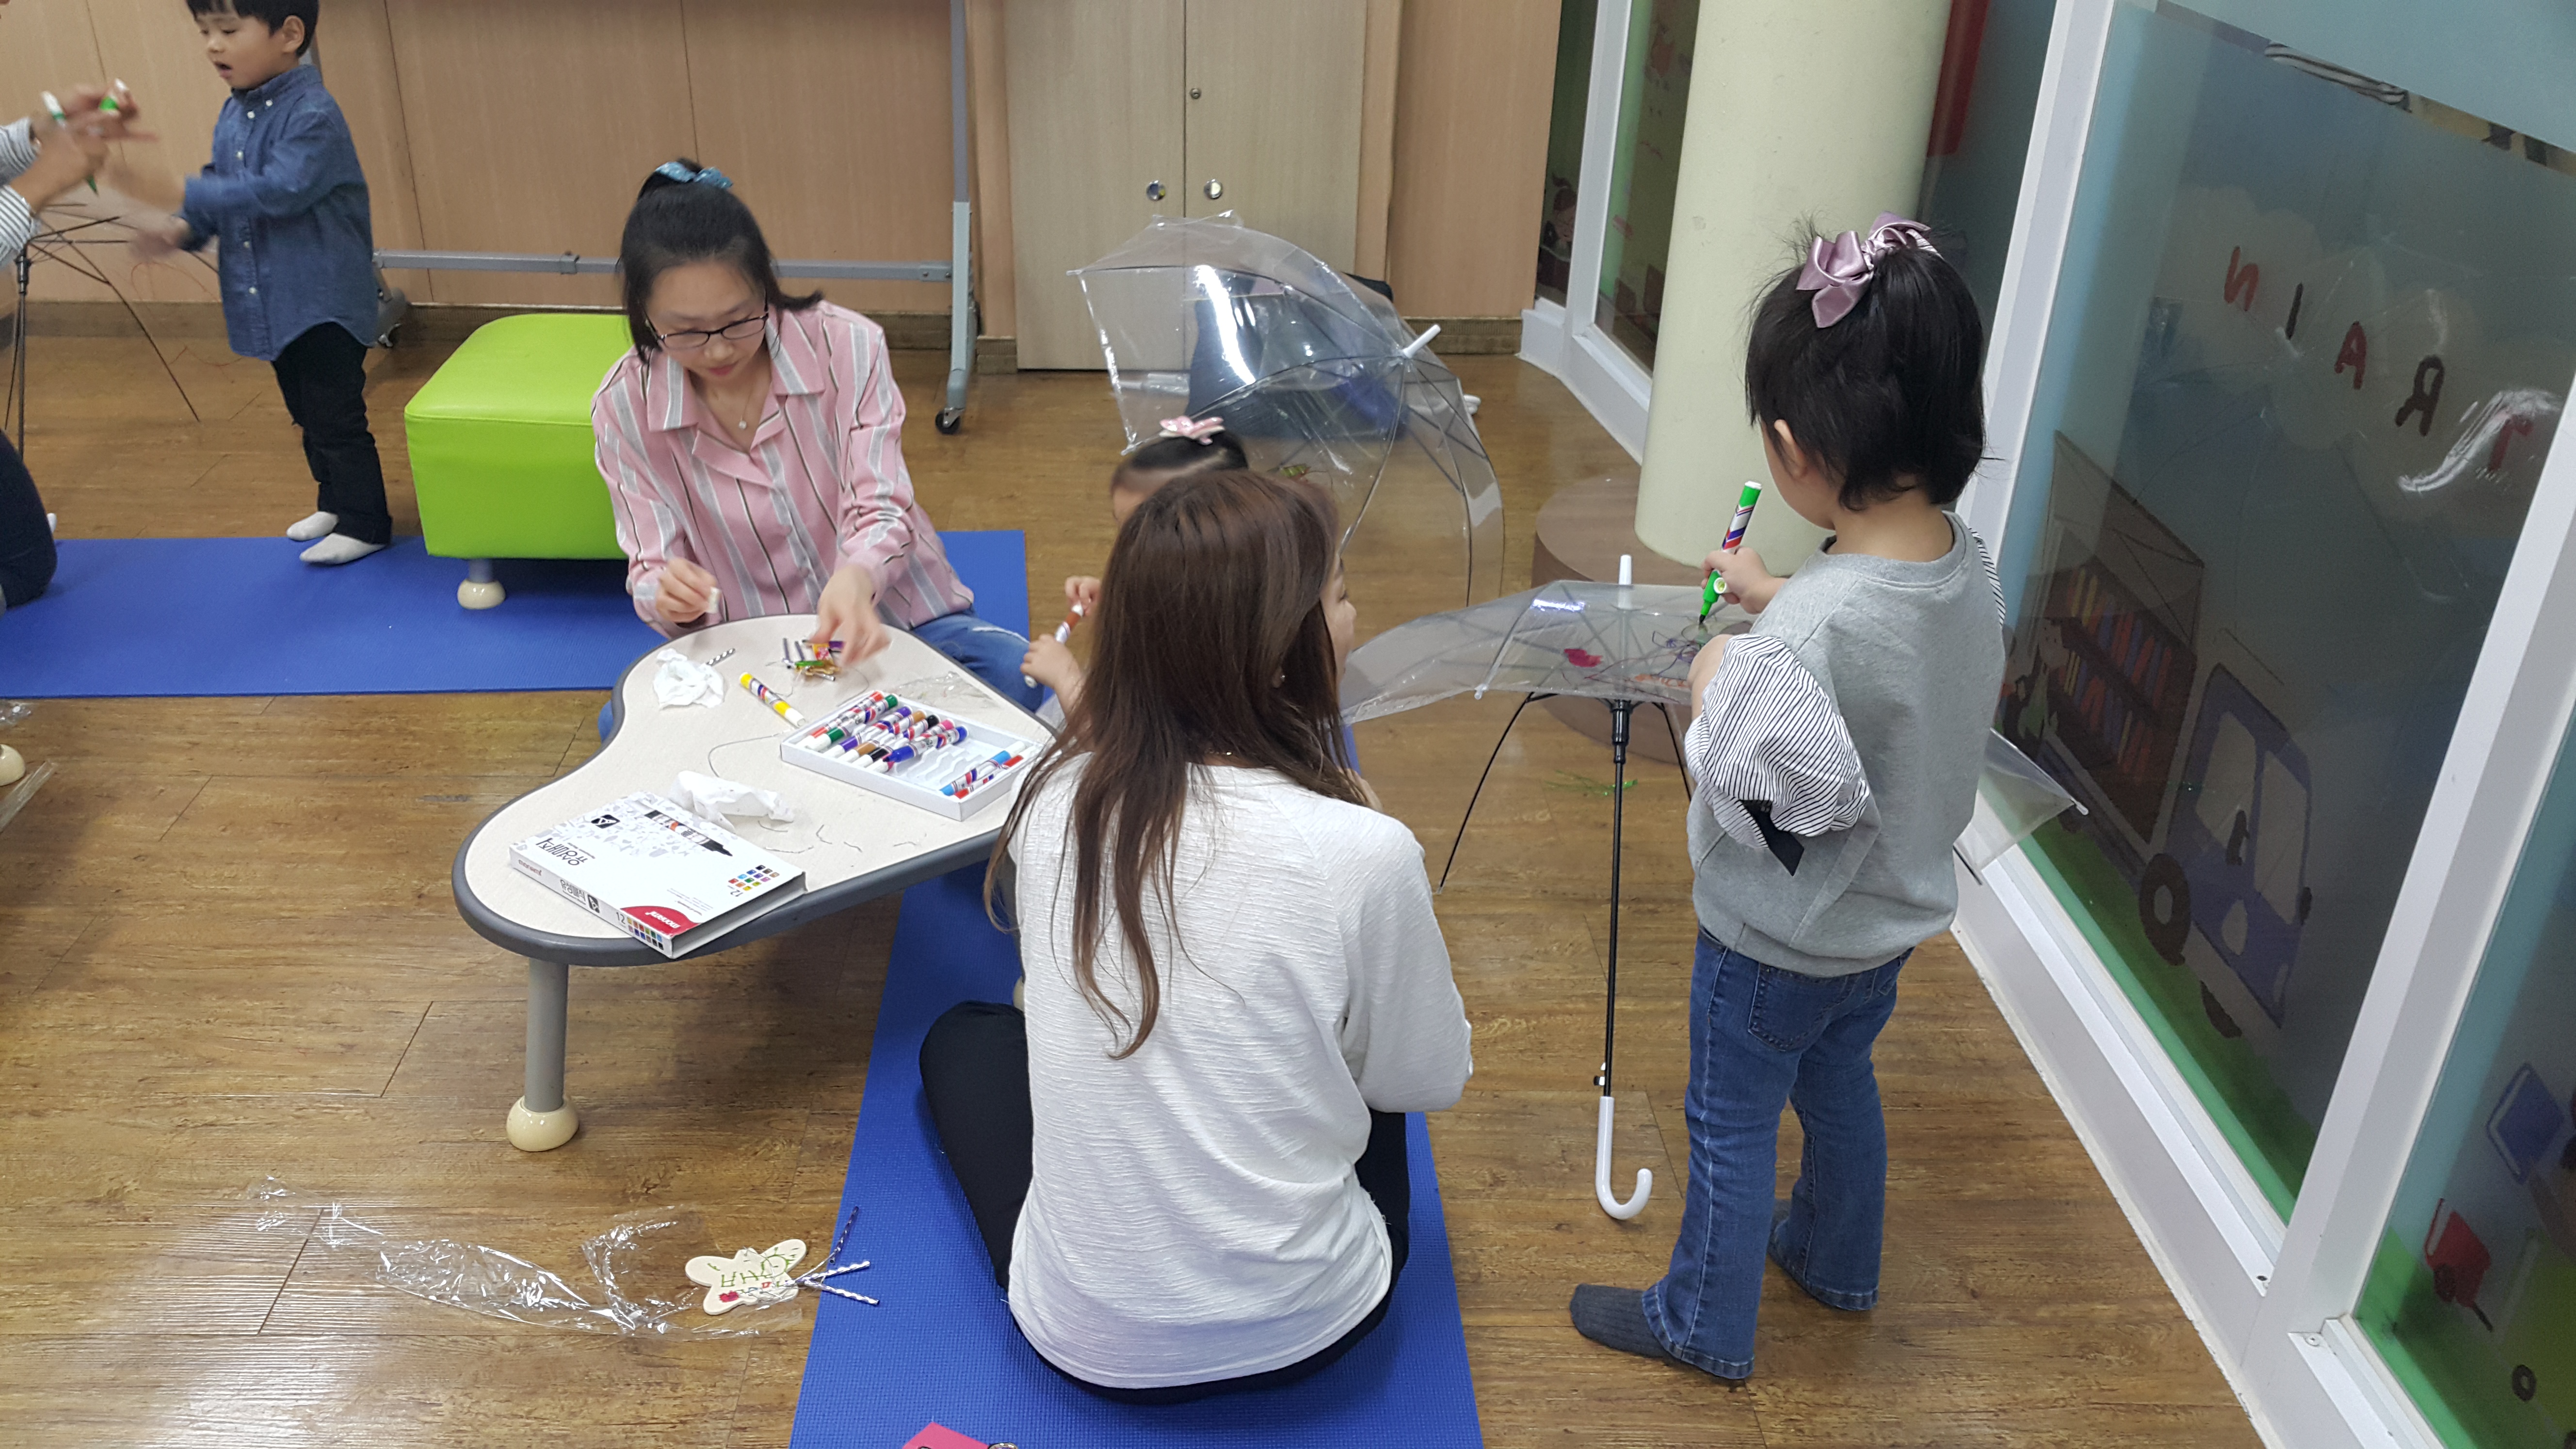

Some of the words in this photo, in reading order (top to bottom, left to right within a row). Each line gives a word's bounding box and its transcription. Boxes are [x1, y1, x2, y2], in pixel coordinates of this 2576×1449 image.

[535, 837, 588, 866] 유성매직
[730, 889, 744, 897] 12
[615, 912, 626, 924] 12
[644, 911, 681, 929] monami
